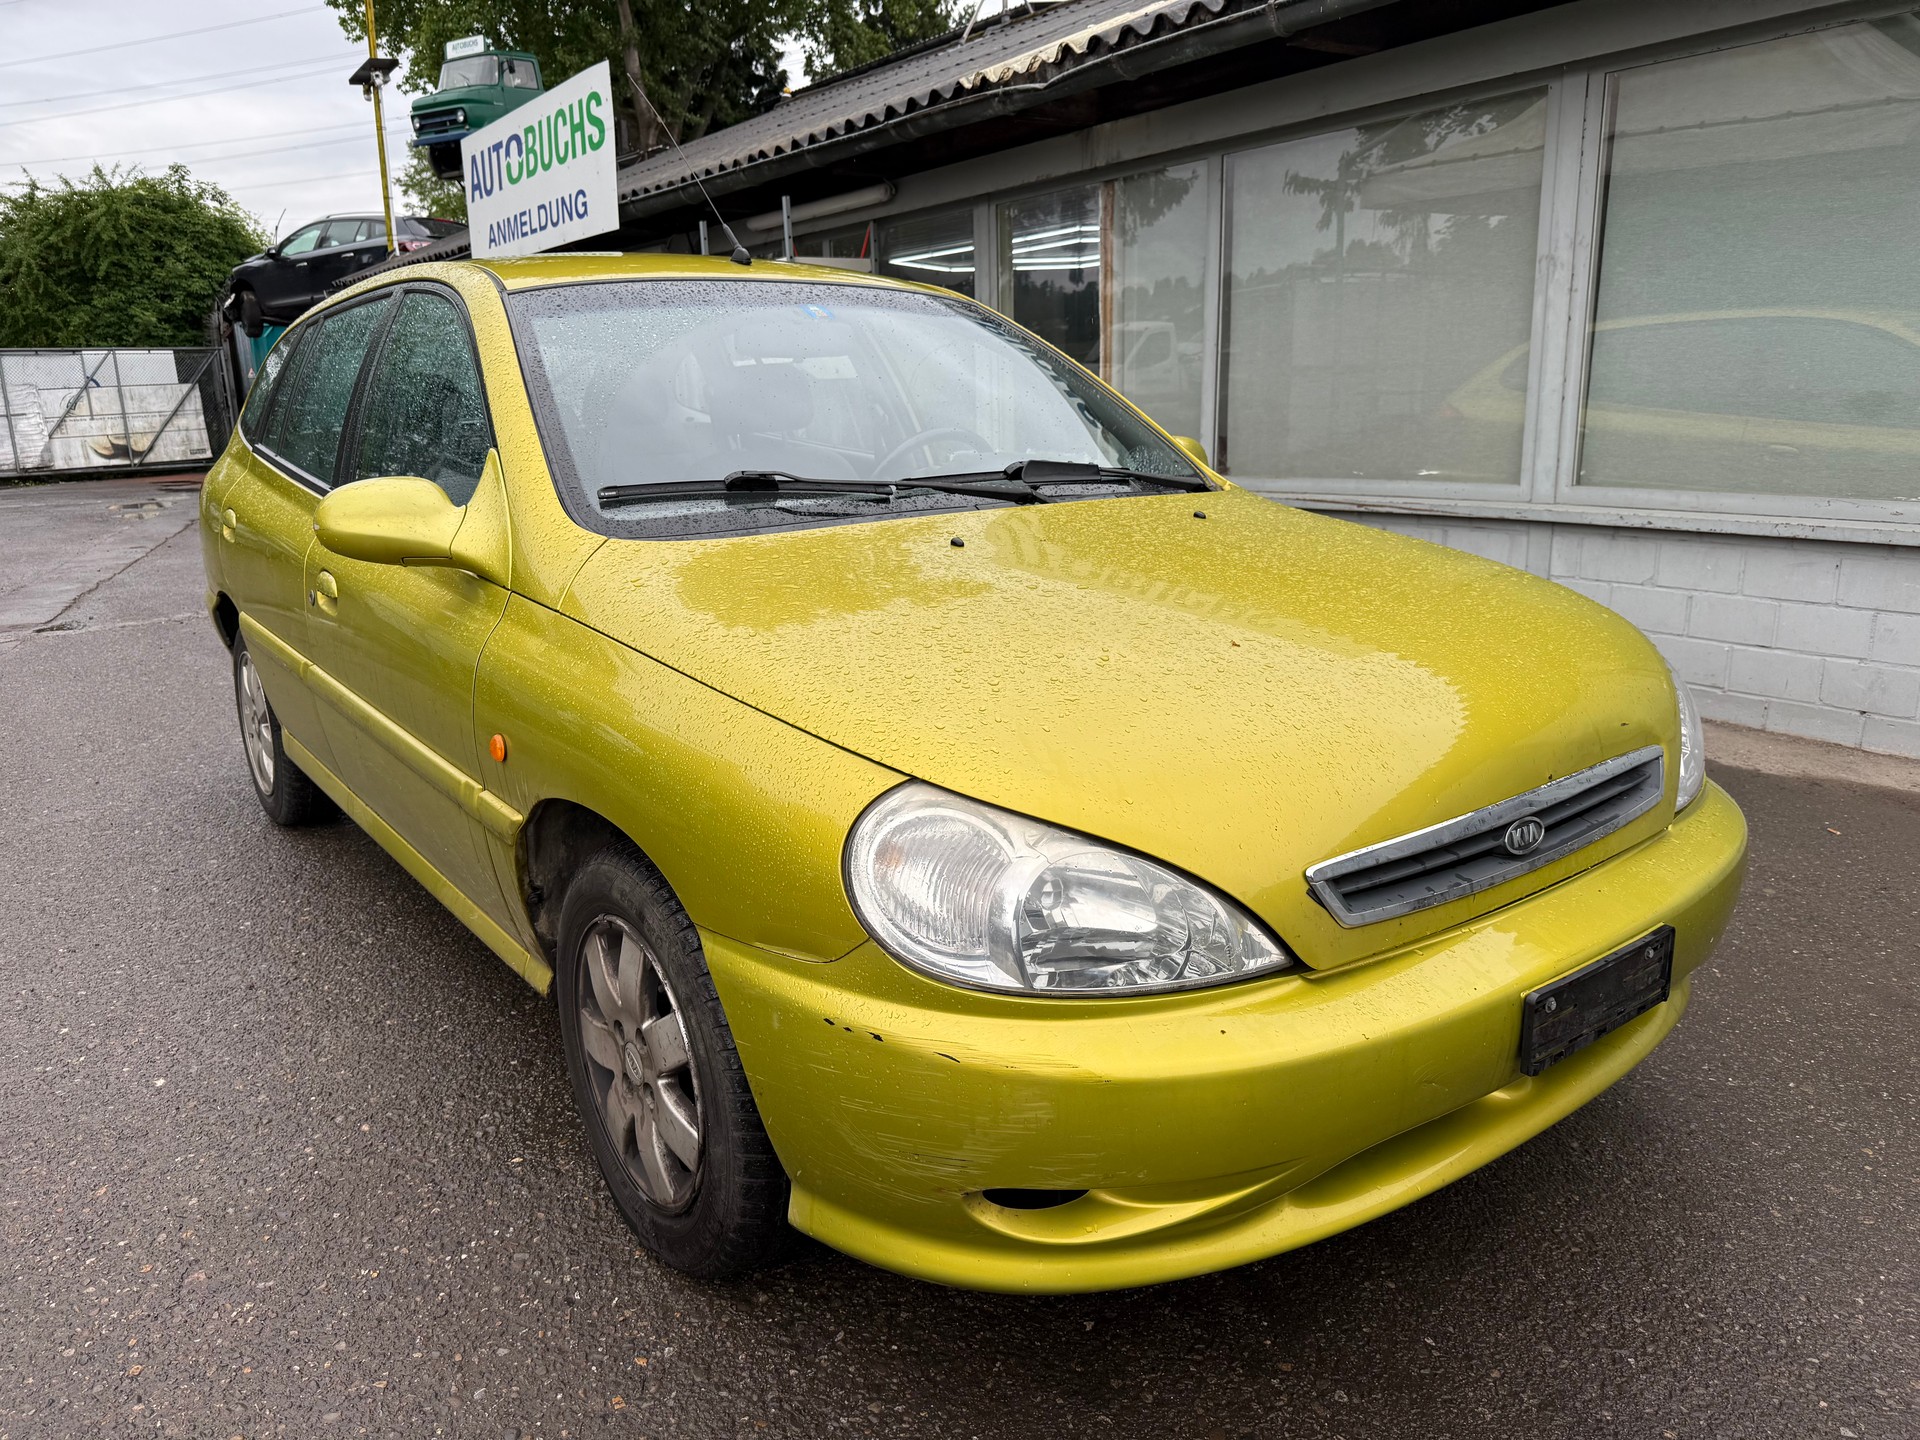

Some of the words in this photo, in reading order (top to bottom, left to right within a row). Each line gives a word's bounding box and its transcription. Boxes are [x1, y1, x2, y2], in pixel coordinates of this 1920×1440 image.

[471, 91, 606, 203] AUTOBUCHS
[488, 189, 589, 249] ANMELDUNG
[1511, 822, 1539, 848] KIA
